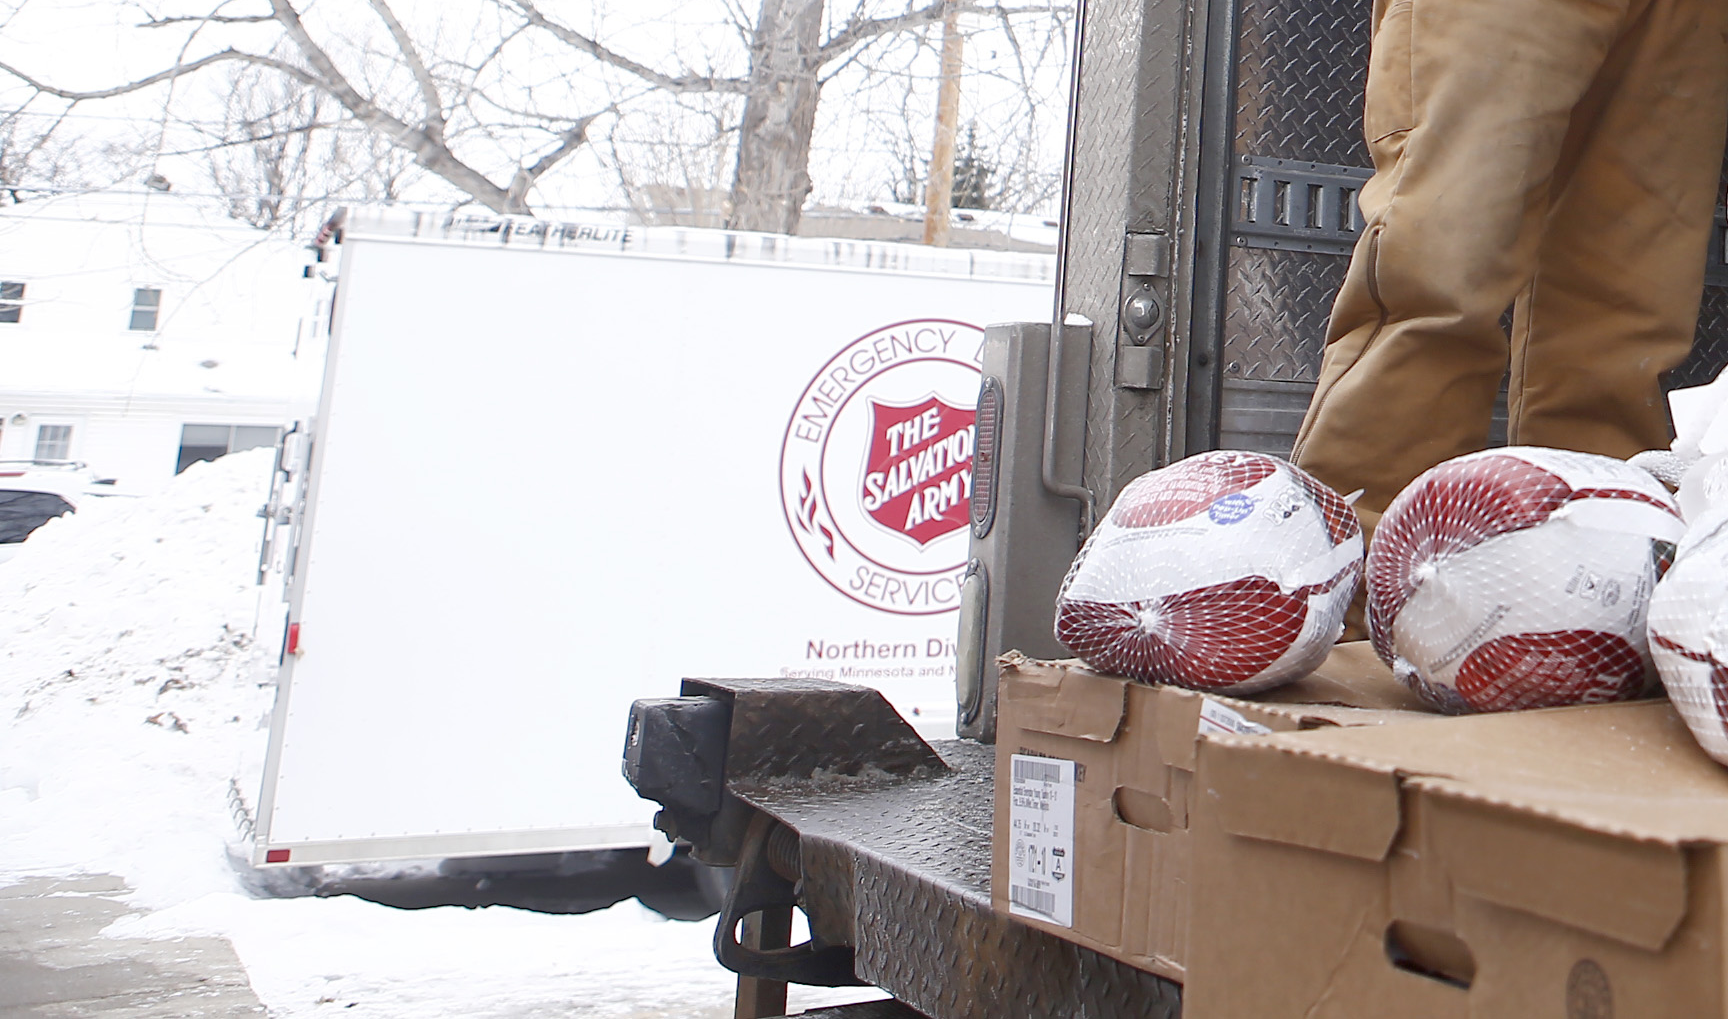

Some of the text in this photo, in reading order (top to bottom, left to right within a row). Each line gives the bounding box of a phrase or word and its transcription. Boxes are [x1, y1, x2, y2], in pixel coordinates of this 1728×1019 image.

[795, 328, 957, 444] EMERGENCY
[886, 406, 941, 457] THE
[904, 469, 972, 531] ARMY
[1213, 503, 1250, 514] Pop-Up
[1224, 498, 1245, 507] with
[1214, 511, 1241, 520] Timer
[806, 639, 917, 660] Northern
[780, 666, 834, 680] Serving
[840, 666, 914, 678] Minnesota
[918, 666, 945, 678] and
